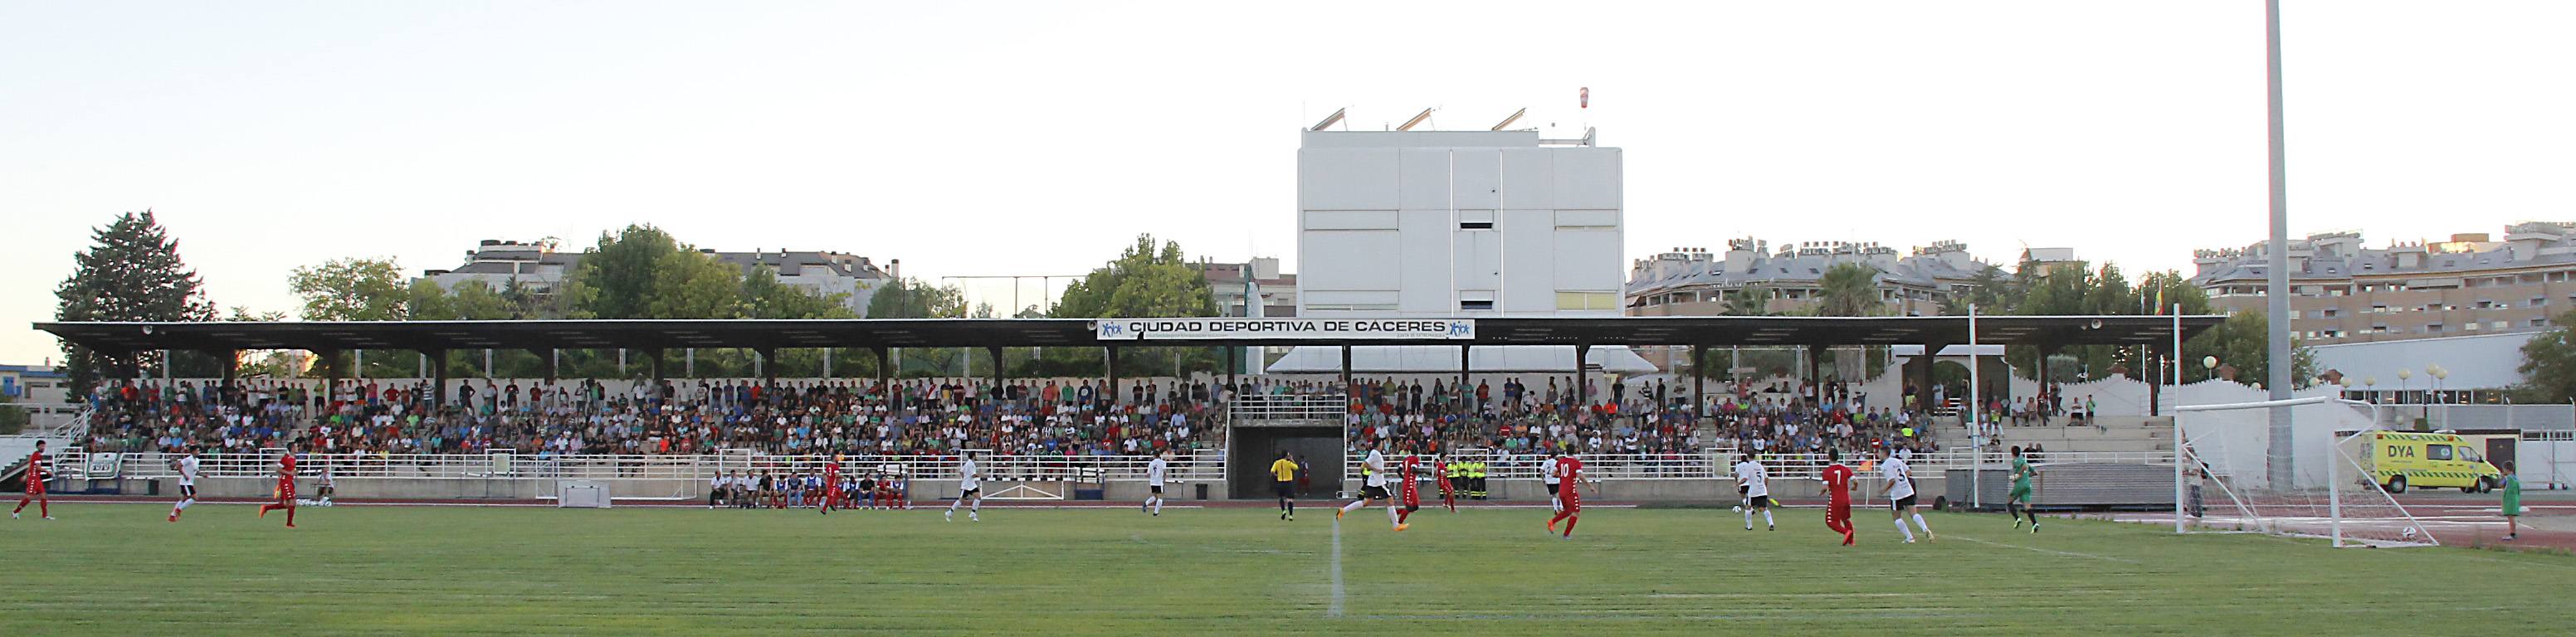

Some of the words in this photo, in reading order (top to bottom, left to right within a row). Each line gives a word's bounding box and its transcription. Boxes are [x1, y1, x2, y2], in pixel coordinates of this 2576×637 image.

[1129, 322, 1203, 332] CIUDAD
[1209, 321, 1317, 332] DEPORTIVA
[1324, 321, 1349, 331] DE
[1354, 319, 1446, 332] CÁCERES
[2388, 445, 2414, 458] DYA
[1546, 465, 1552, 475] 2
[1560, 463, 1569, 478] 10
[1896, 468, 1905, 482] 3
[1756, 471, 1762, 484] 5
[1834, 469, 1842, 485] 7
